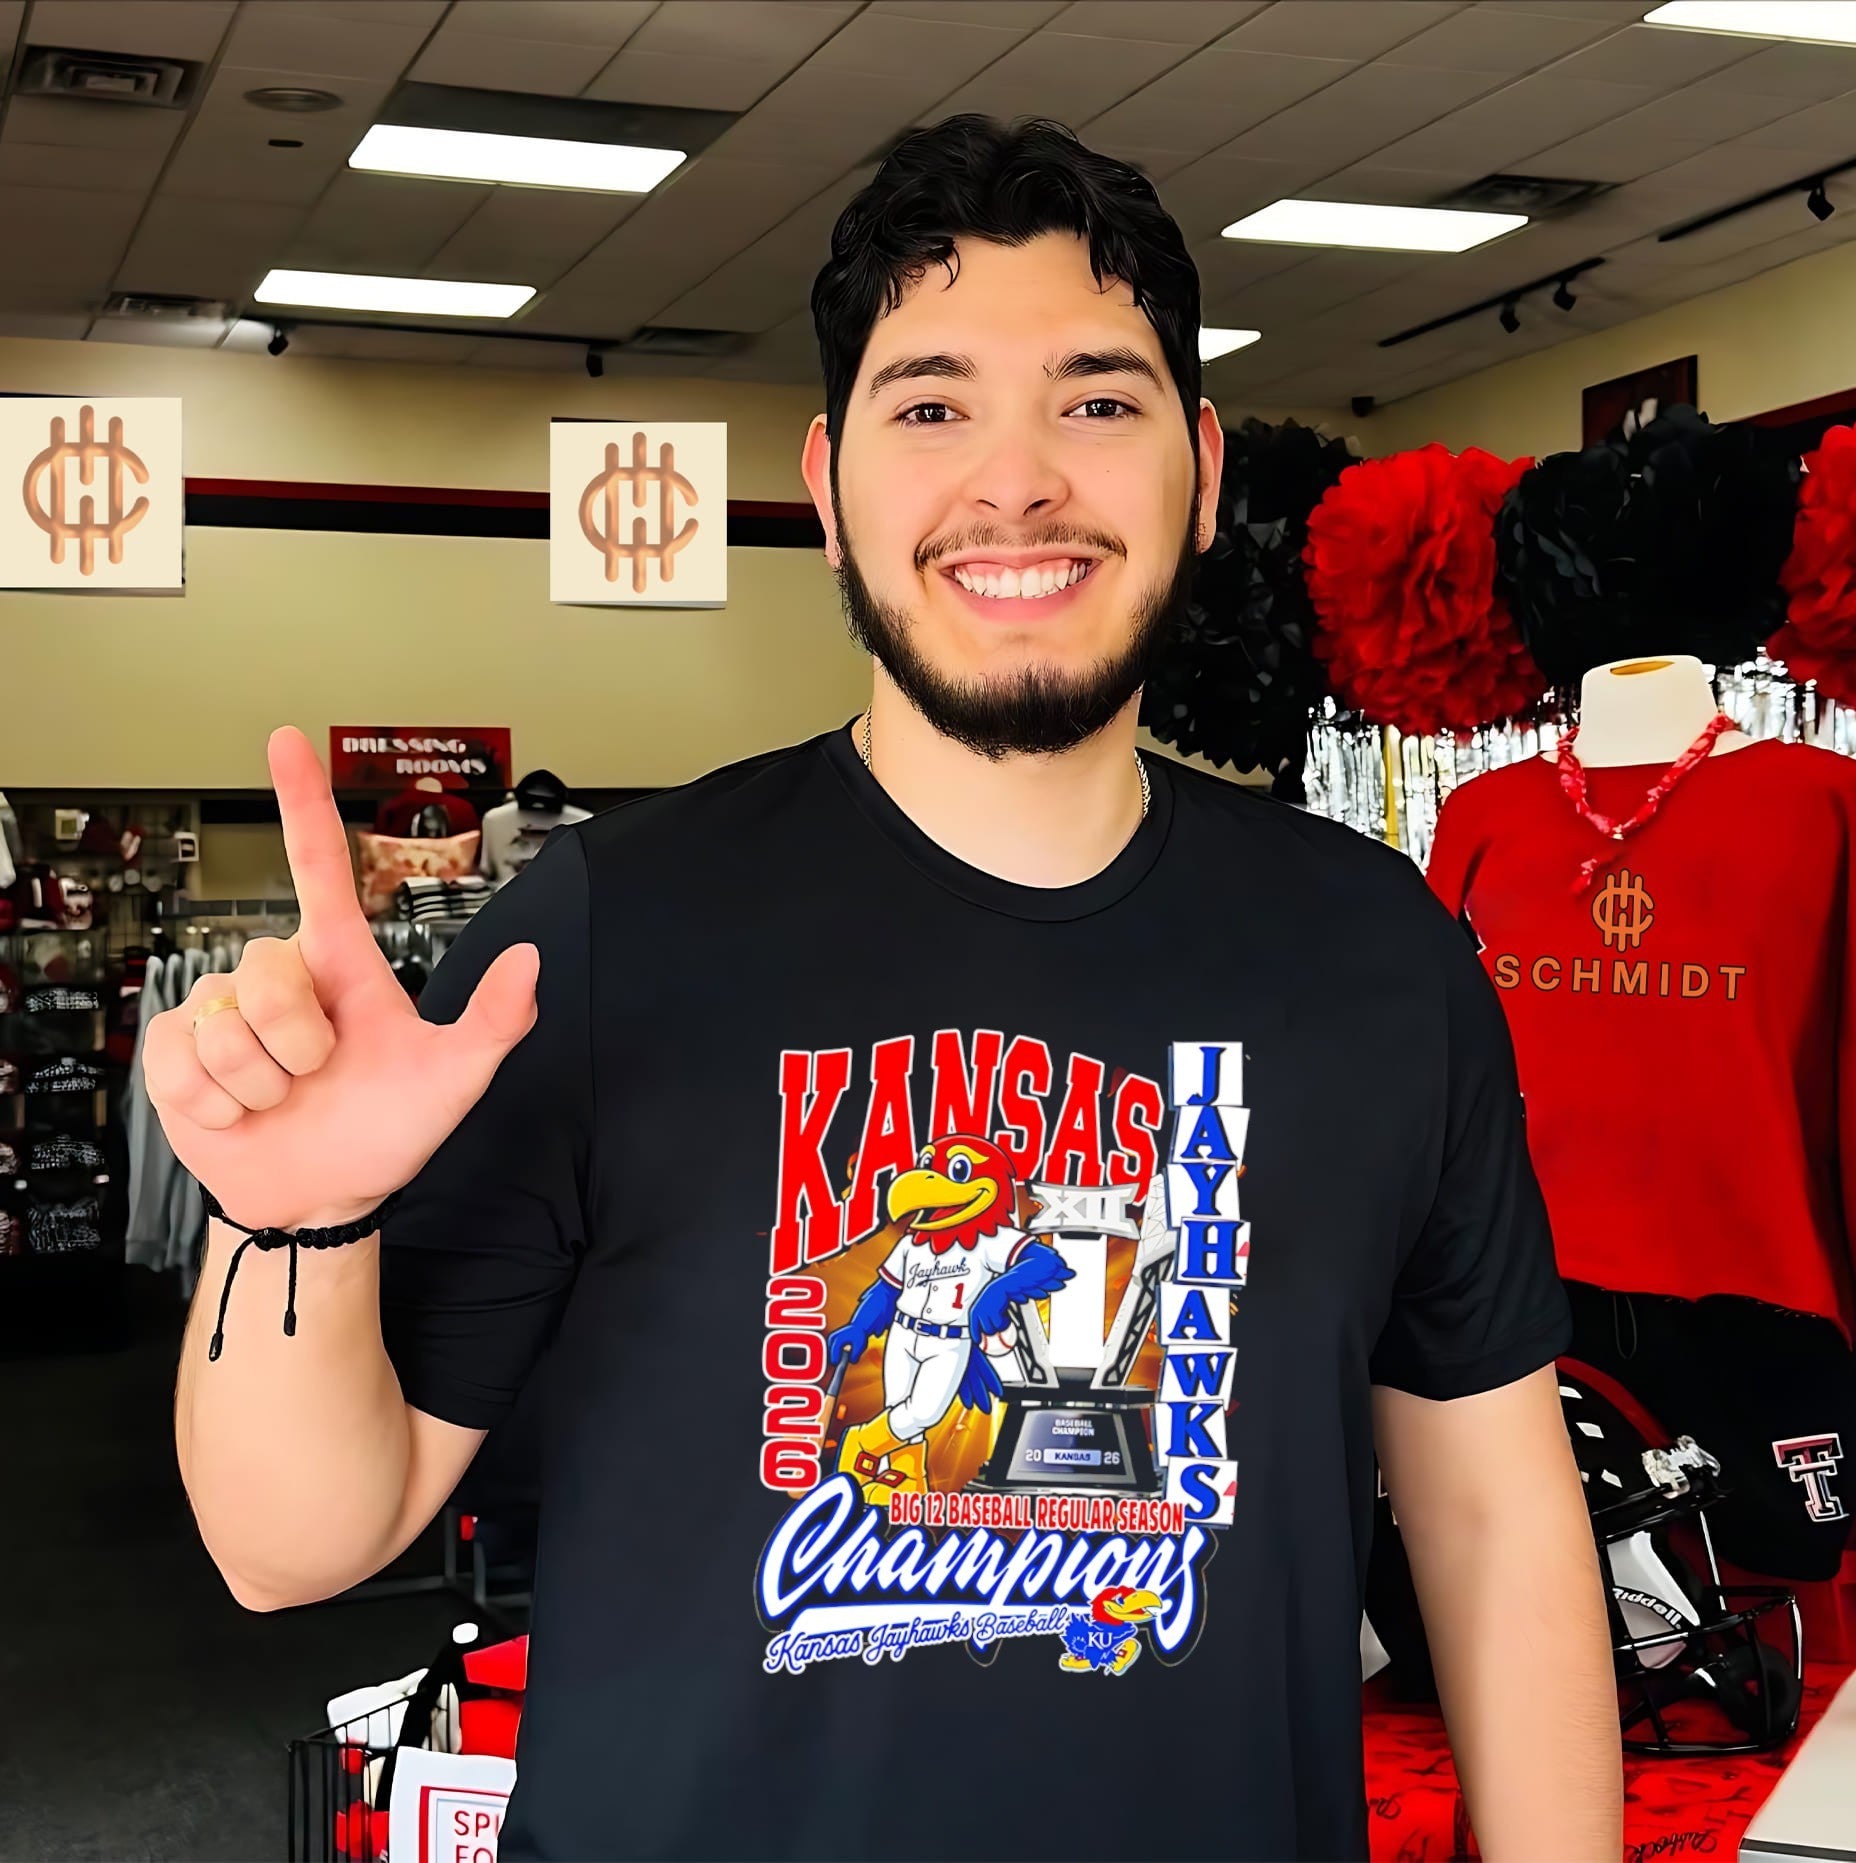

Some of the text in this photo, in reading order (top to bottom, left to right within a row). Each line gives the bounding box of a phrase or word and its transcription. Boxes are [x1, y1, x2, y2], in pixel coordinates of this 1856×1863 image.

[396, 759, 487, 774] ROOMS
[1494, 953, 1747, 1000] SCHMIDT
[771, 1029, 1165, 1277] KANSAS
[906, 1256, 971, 1289] Jayhawk
[1165, 1045, 1244, 1520] JAYHAWKS
[952, 1282, 965, 1310] 1
[760, 1275, 828, 1491] 2026
[1052, 1427, 1095, 1436] CHAMPION
[1055, 1419, 1093, 1428] BASEBALL
[1025, 1449, 1121, 1465] 20 KANSAS 26
[889, 1492, 1185, 1534] BIG 12 BASEBALL REGULAR SEASON
[760, 1473, 1207, 1654] Champions
[763, 1606, 1069, 1674] Kansas Jayhawks Baseball
[1087, 1631, 1113, 1650] KU
